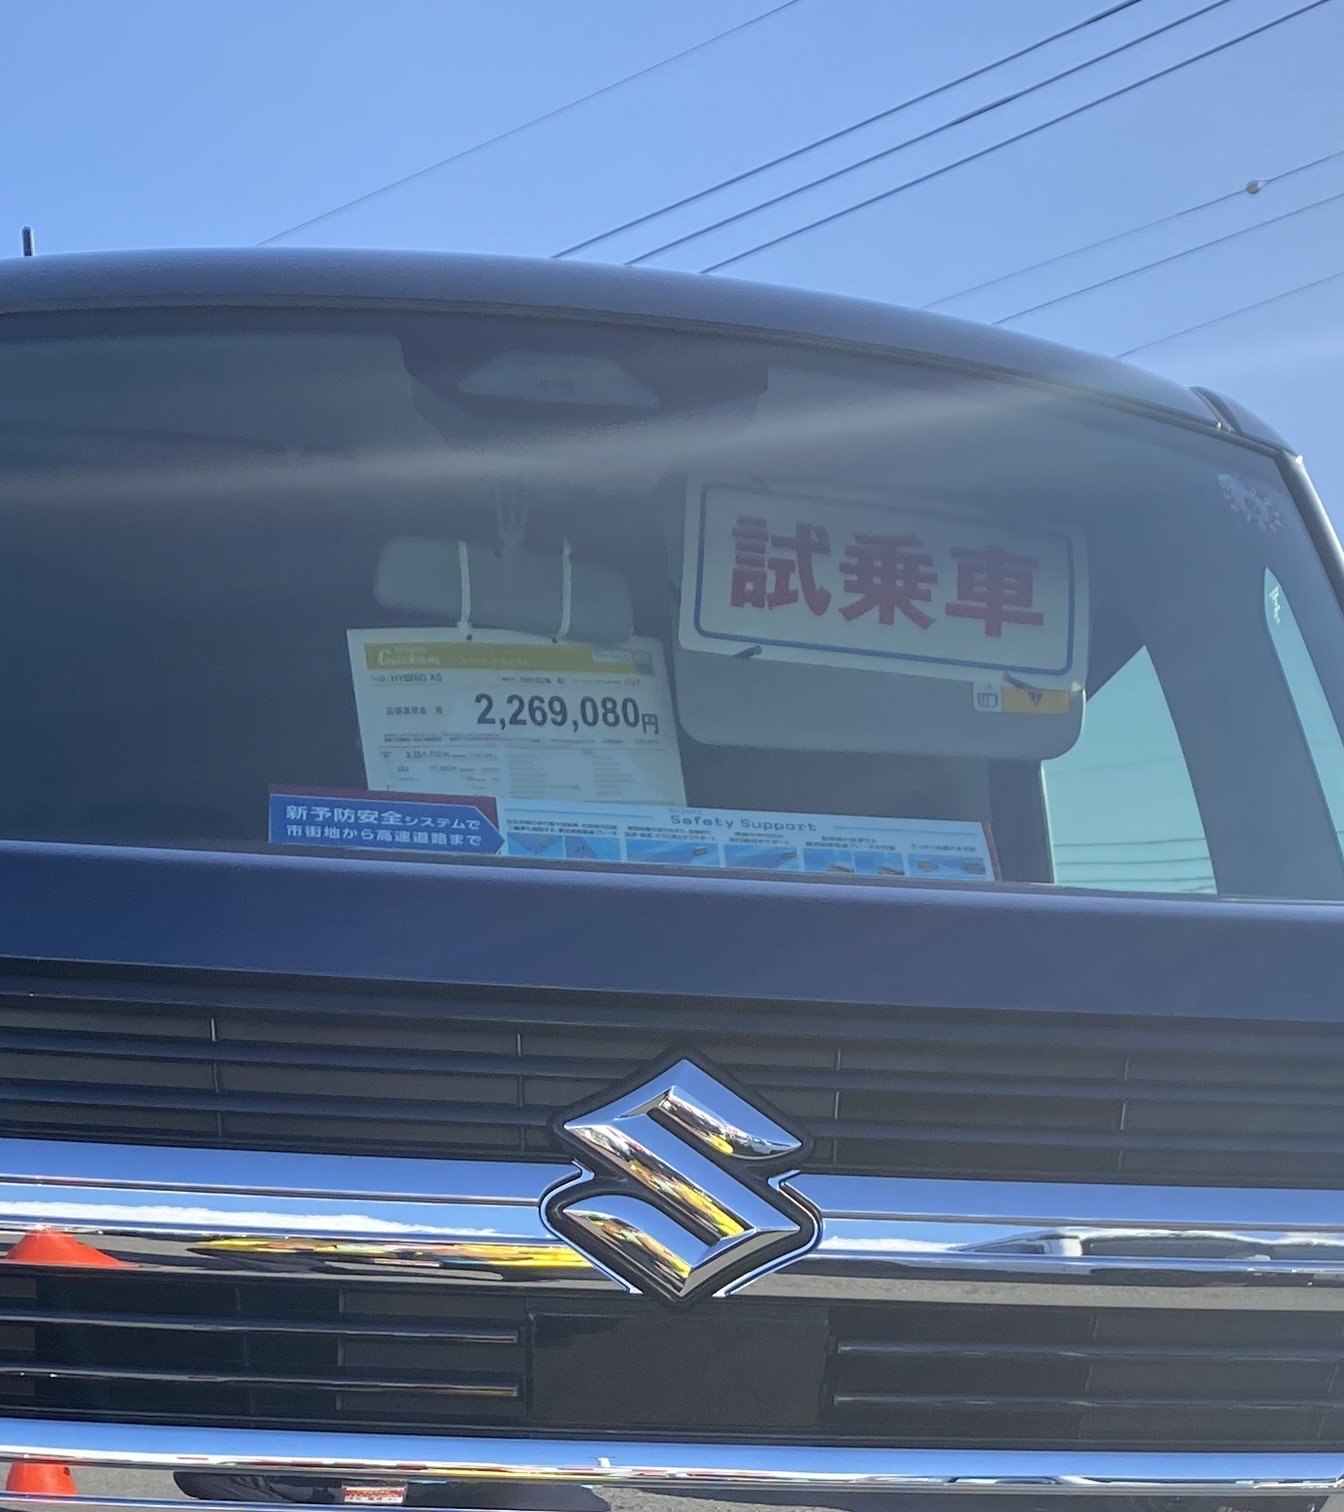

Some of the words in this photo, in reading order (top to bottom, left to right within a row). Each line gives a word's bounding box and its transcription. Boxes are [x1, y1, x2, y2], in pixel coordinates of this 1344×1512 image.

[731, 515, 1044, 638] 試乗車
[474, 692, 659, 734] 2,269,080円
[286, 804, 481, 830] 新予防安全システムで
[670, 814, 735, 829] Safety
[740, 817, 817, 832] Support
[287, 823, 483, 846] 市街地から高速道路まで
